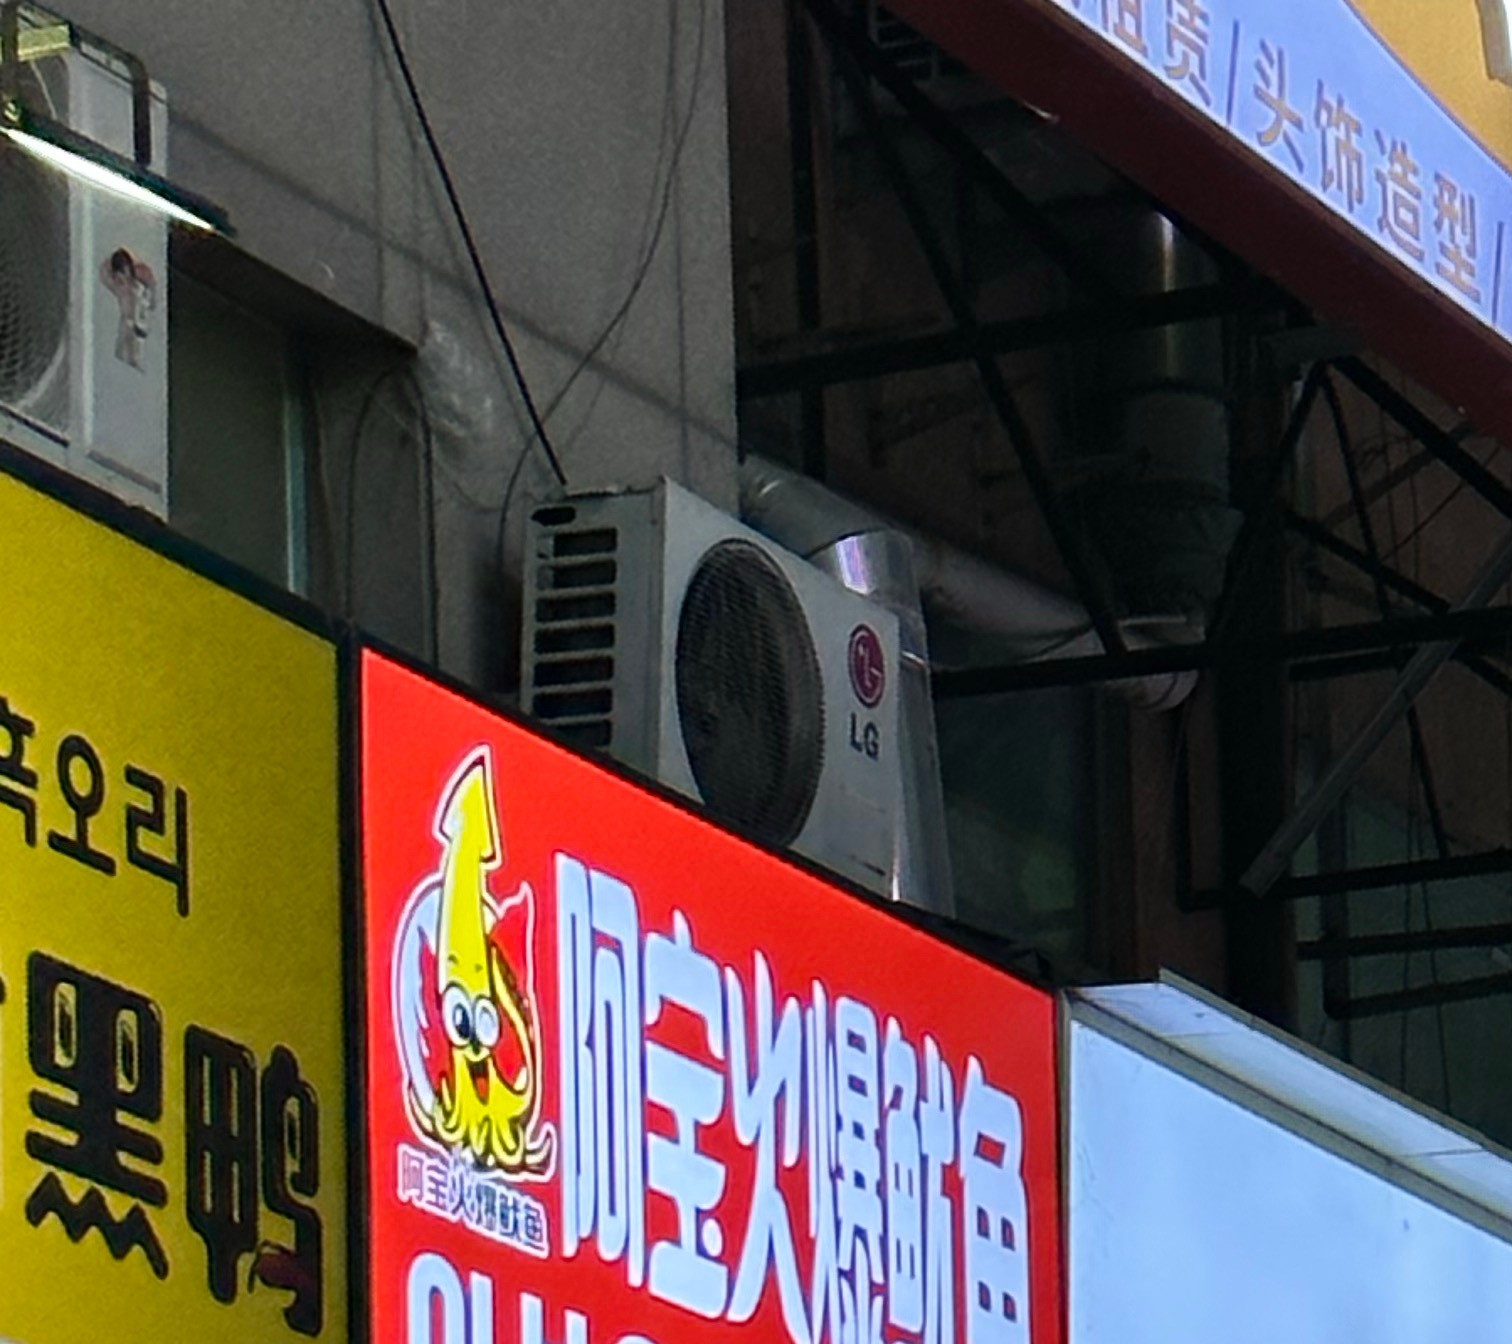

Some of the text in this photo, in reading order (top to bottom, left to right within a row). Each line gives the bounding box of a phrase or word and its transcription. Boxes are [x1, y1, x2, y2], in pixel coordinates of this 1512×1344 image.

[1253, 38, 1482, 304] 头饰造型
[849, 713, 880, 763] LG
[25, 950, 324, 1338] 黑鸭
[398, 1148, 548, 1258] 阿宝火爆鱿鱼
